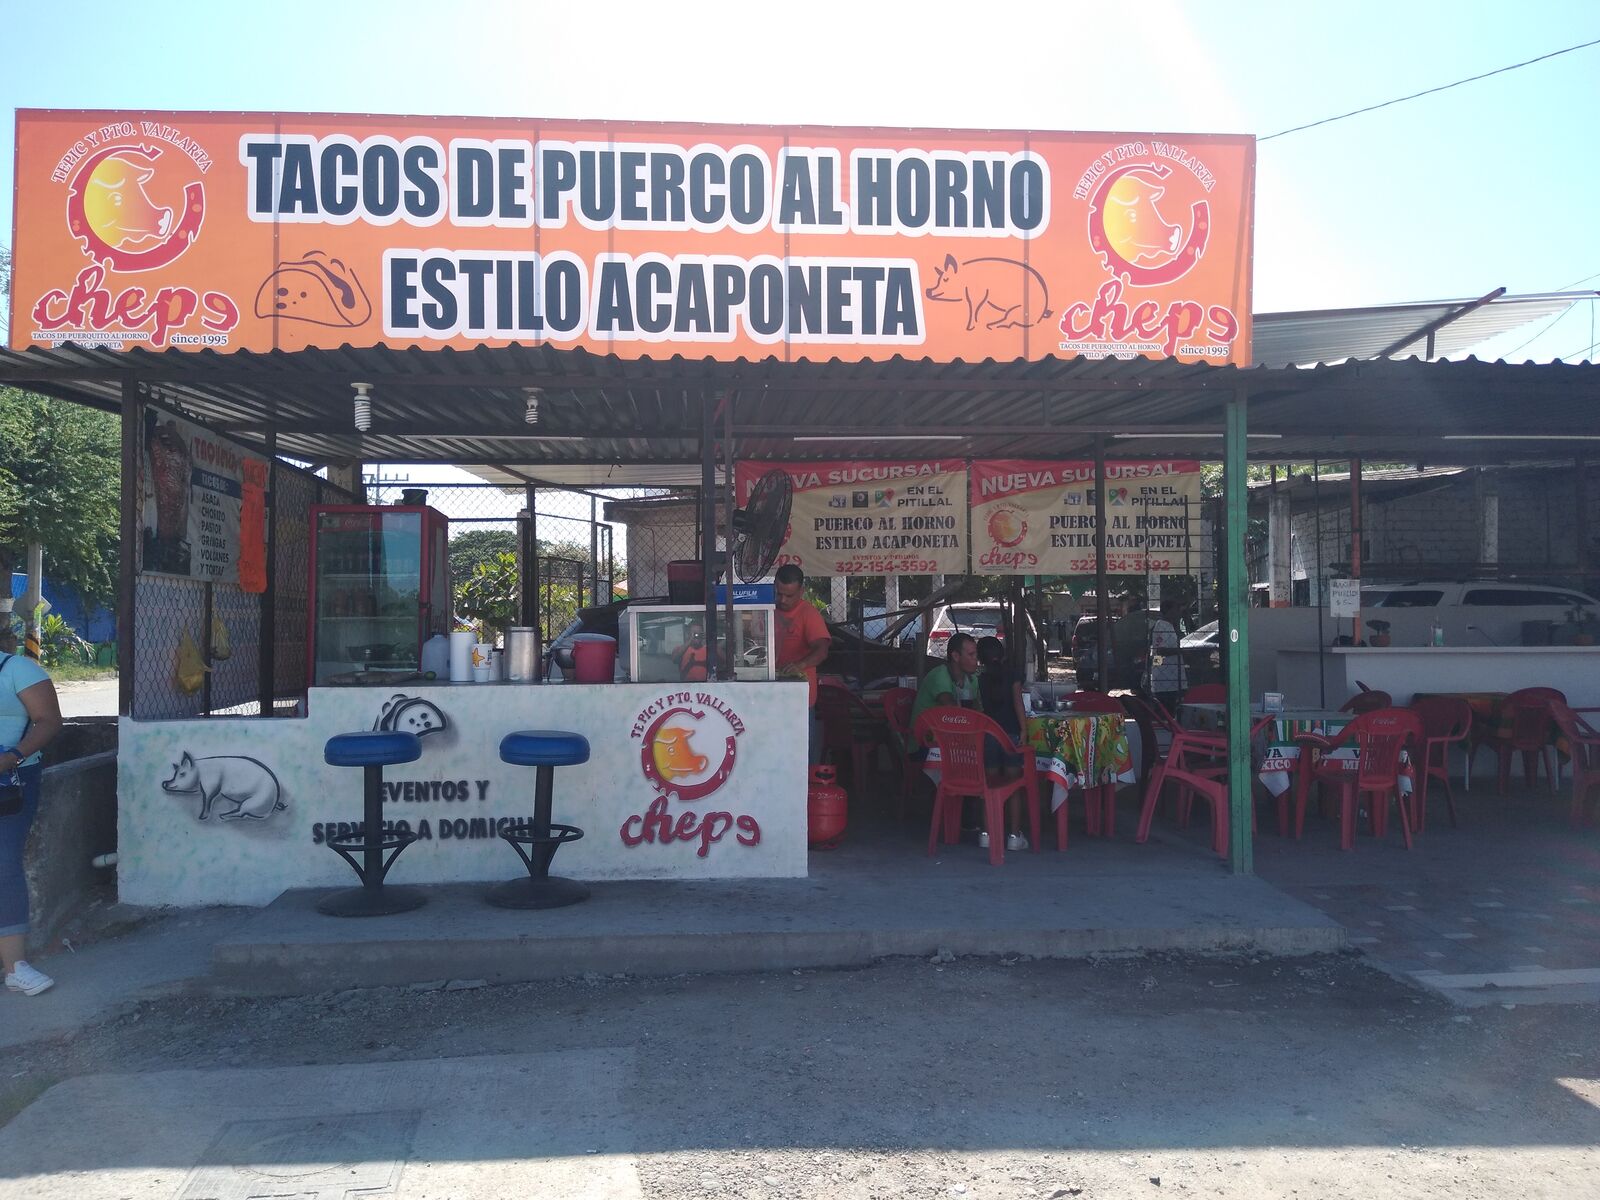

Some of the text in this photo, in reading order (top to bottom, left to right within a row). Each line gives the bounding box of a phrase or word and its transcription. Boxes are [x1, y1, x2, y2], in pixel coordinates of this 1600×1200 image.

[51, 121, 212, 183] TEPIC Y PTO. VALLARTA
[1073, 141, 1216, 200] TEPIC Y PTO. VALLARTA
[245, 141, 1044, 231] TACOS DE PUERCO AL HORNO
[389, 256, 920, 336] ESTILO ACAPONETA
[68, 332, 109, 341] PUERQUITO
[121, 332, 148, 340] HORNO
[171, 334, 228, 345] since 1995
[1181, 346, 1228, 355] since 1995
[828, 463, 947, 484] SUCURSAL
[907, 486, 943, 495] EN EL
[981, 471, 1056, 496] NUEVA
[1140, 486, 1176, 495] EN EL
[898, 497, 952, 507] PITILLAL
[814, 516, 955, 531] PUERCO AL HORNO
[1049, 515, 1107, 529] PUERC
[1112, 515, 1130, 529] AL
[815, 534, 959, 550] ESTILO ACAPONETA
[1106, 534, 1192, 548] ACAPONETA
[835, 560, 938, 573] 322-154-3592
[1070, 559, 1170, 571] 32254-3592
[631, 692, 746, 739] TEPIC Y PTO. VALLARTA
[381, 780, 490, 803] EVENTOS Y
[312, 816, 540, 845] SERVIO A DOMICILI
